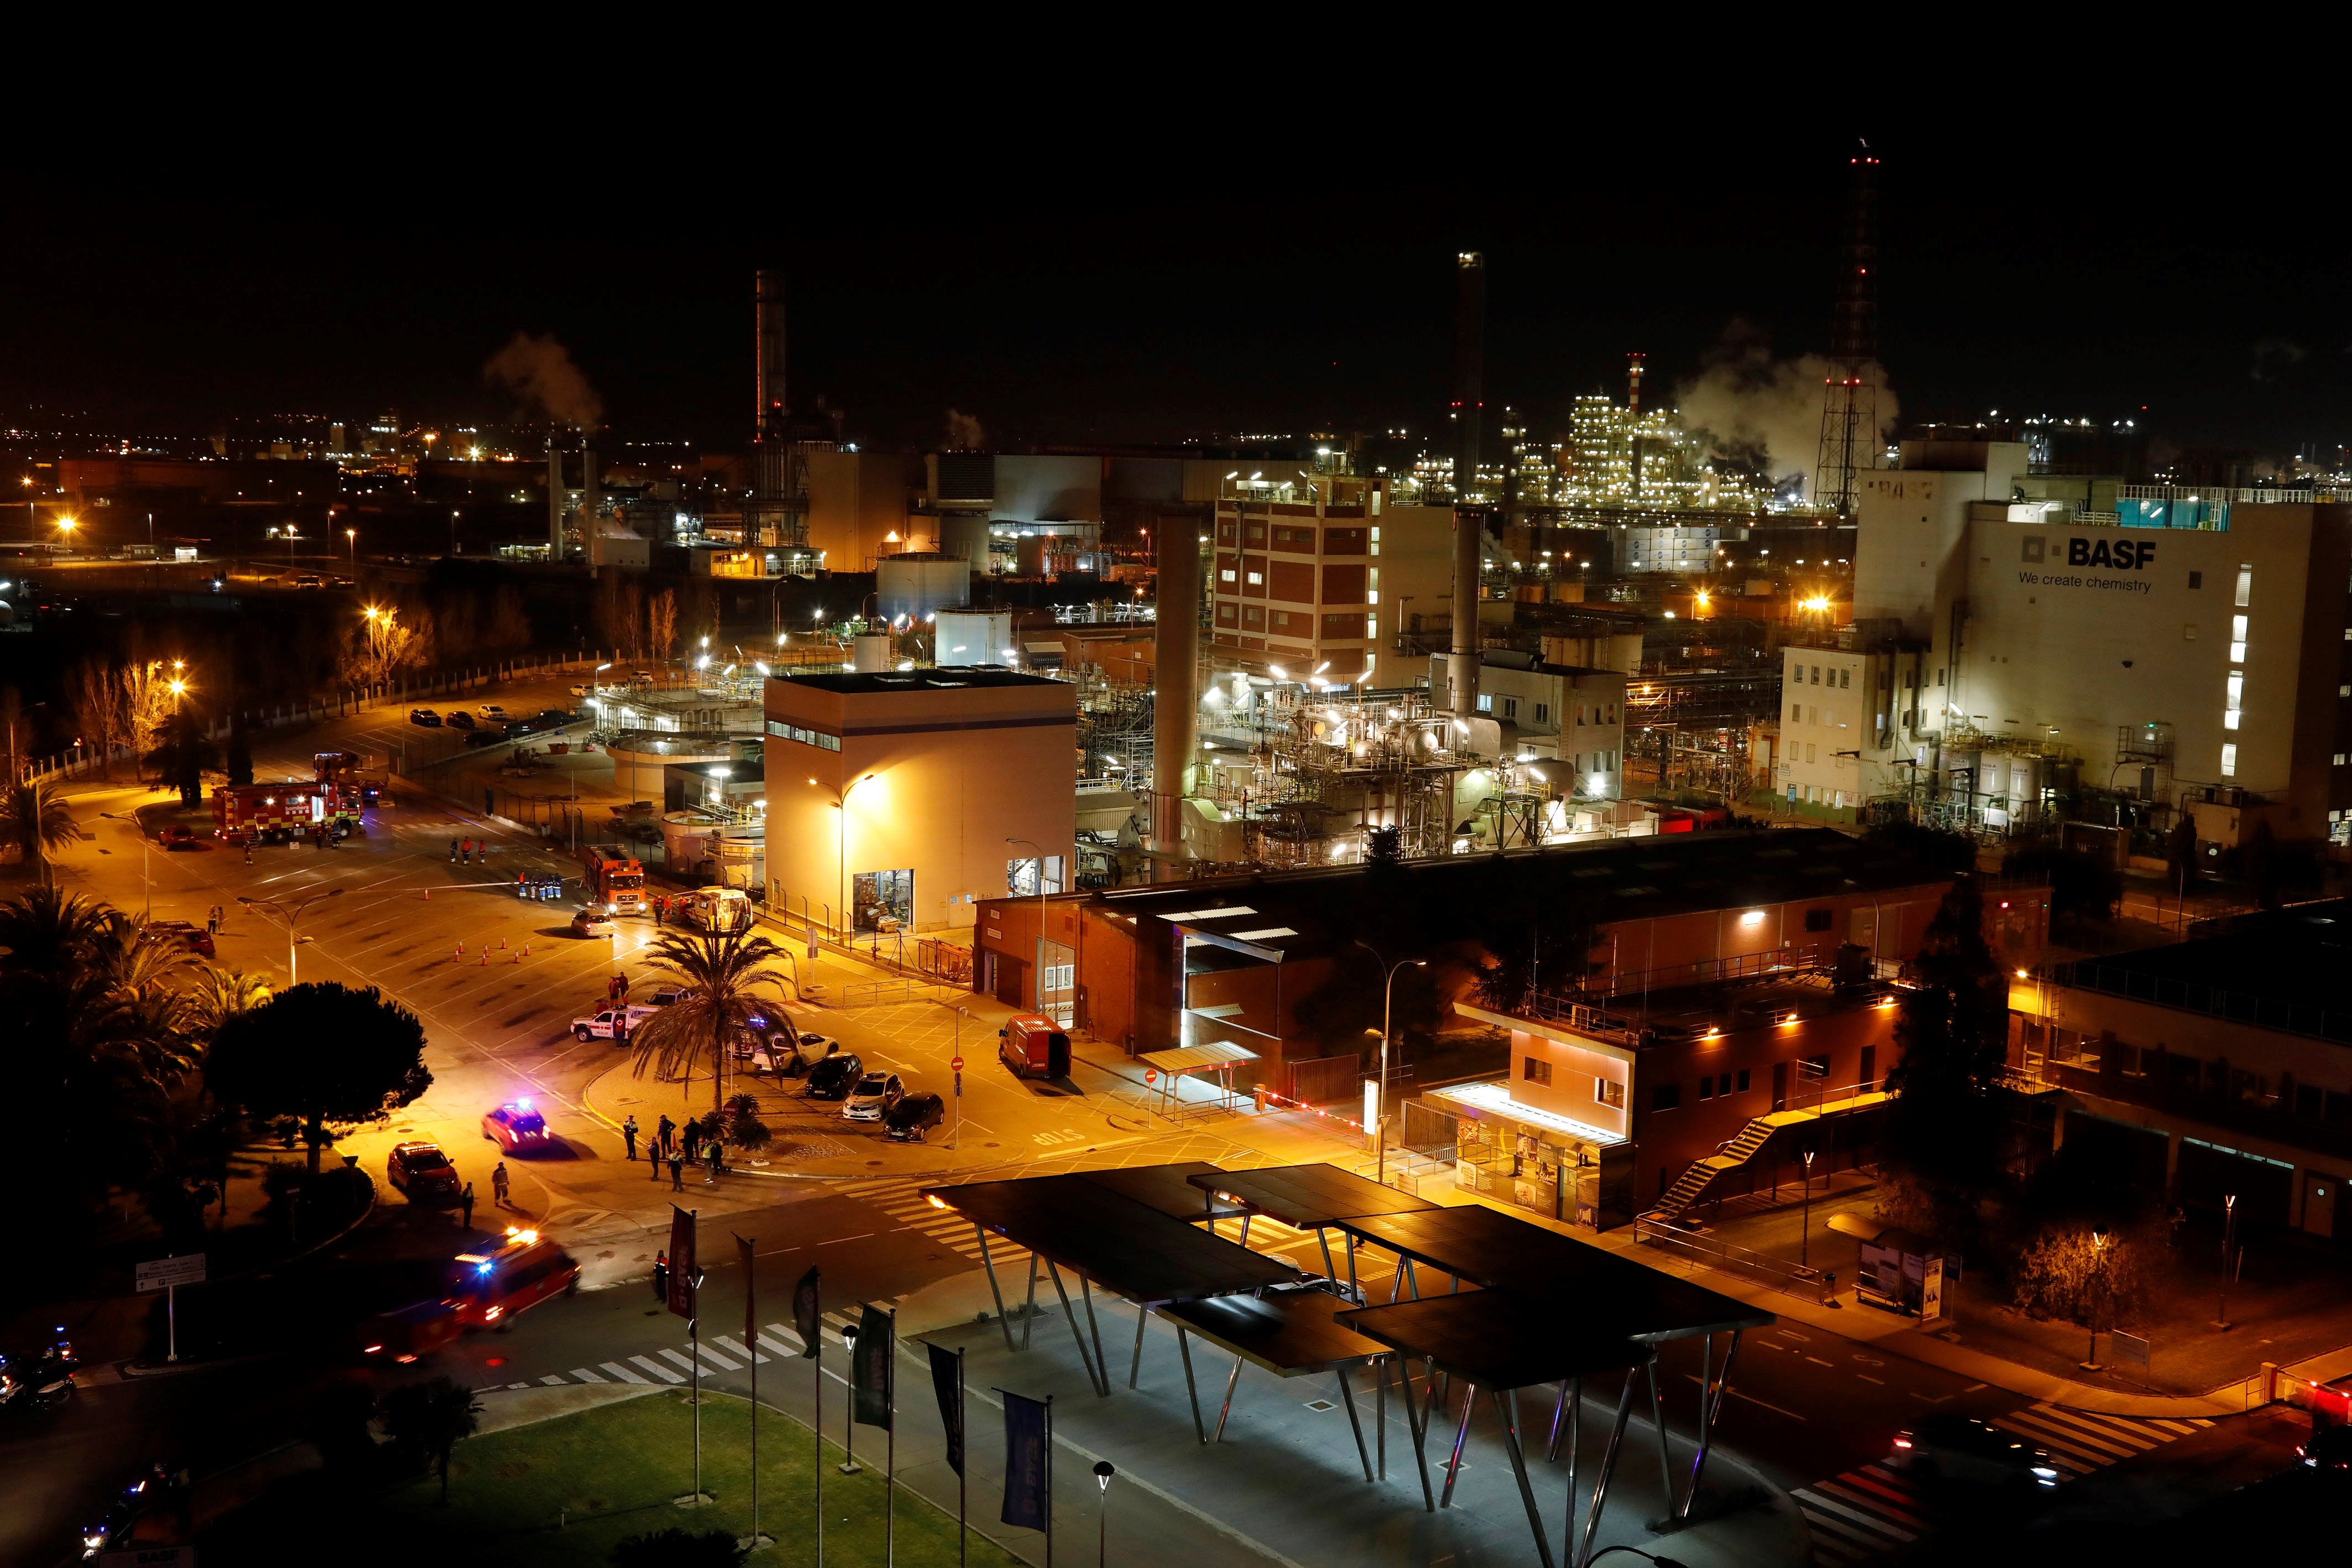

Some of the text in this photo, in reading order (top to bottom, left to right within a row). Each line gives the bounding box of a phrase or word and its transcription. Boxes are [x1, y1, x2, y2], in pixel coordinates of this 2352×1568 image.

[2068, 538, 2156, 570] BASF
[2019, 571, 2152, 595] We create chemistry
[1032, 1128, 1086, 1146] STOP
